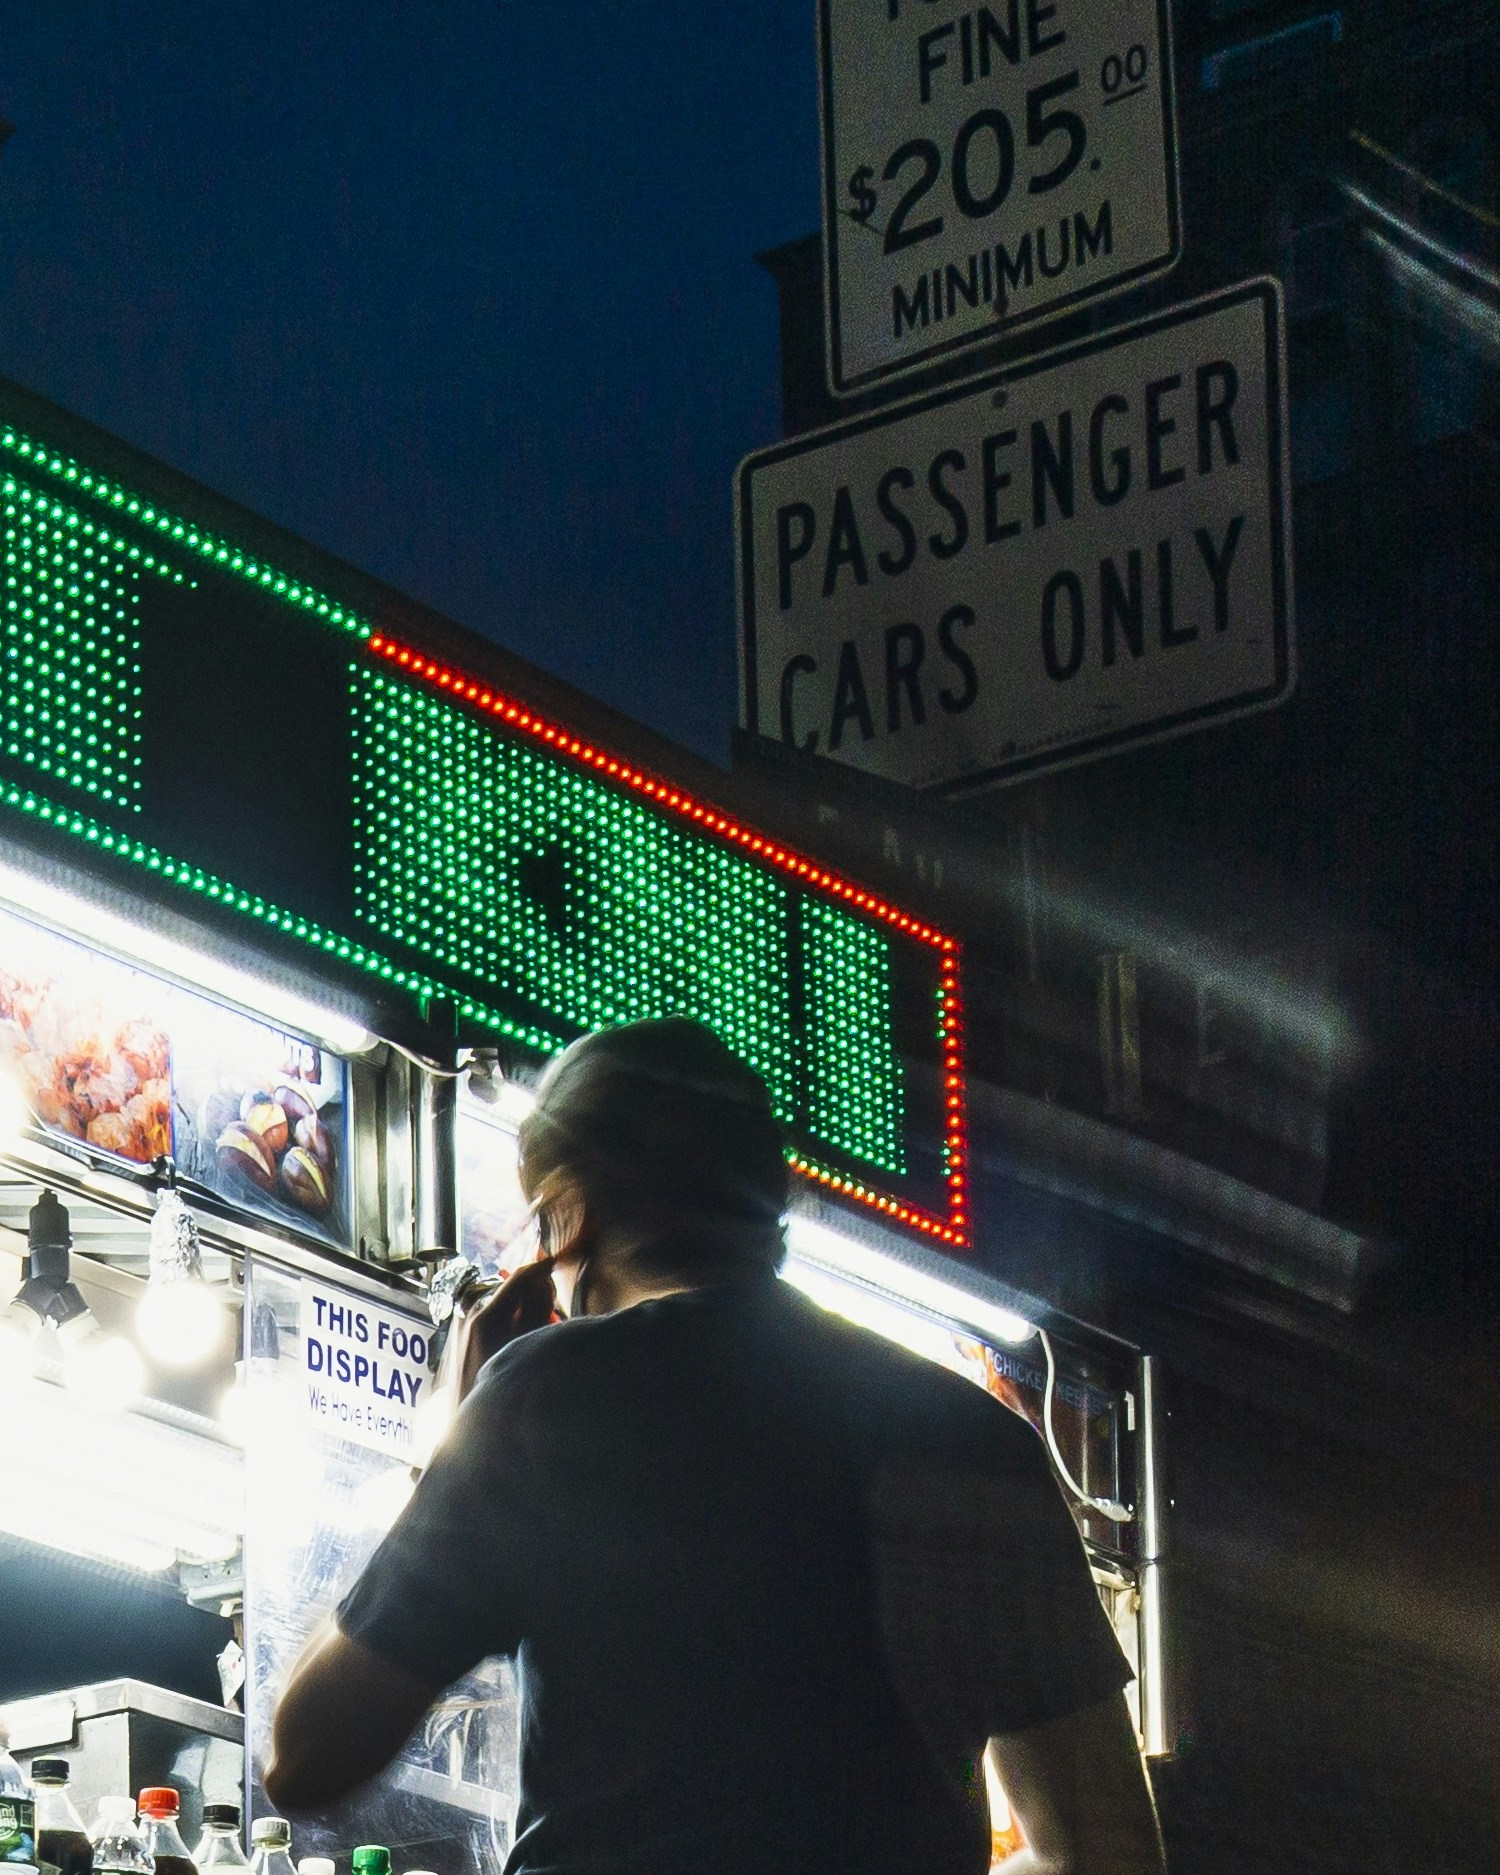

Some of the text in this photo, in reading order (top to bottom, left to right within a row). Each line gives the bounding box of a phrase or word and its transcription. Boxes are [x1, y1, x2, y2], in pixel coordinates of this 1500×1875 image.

[917, 0, 1067, 104] FINE
[892, 199, 1114, 338] MINIMUM
[777, 360, 1239, 612] PASSENGER
[780, 515, 1246, 754] CARS ONLY
[307, 1336, 424, 1408] DISPLAY
[312, 1295, 427, 1365] THIS FOO
[308, 1384, 328, 1415] We
